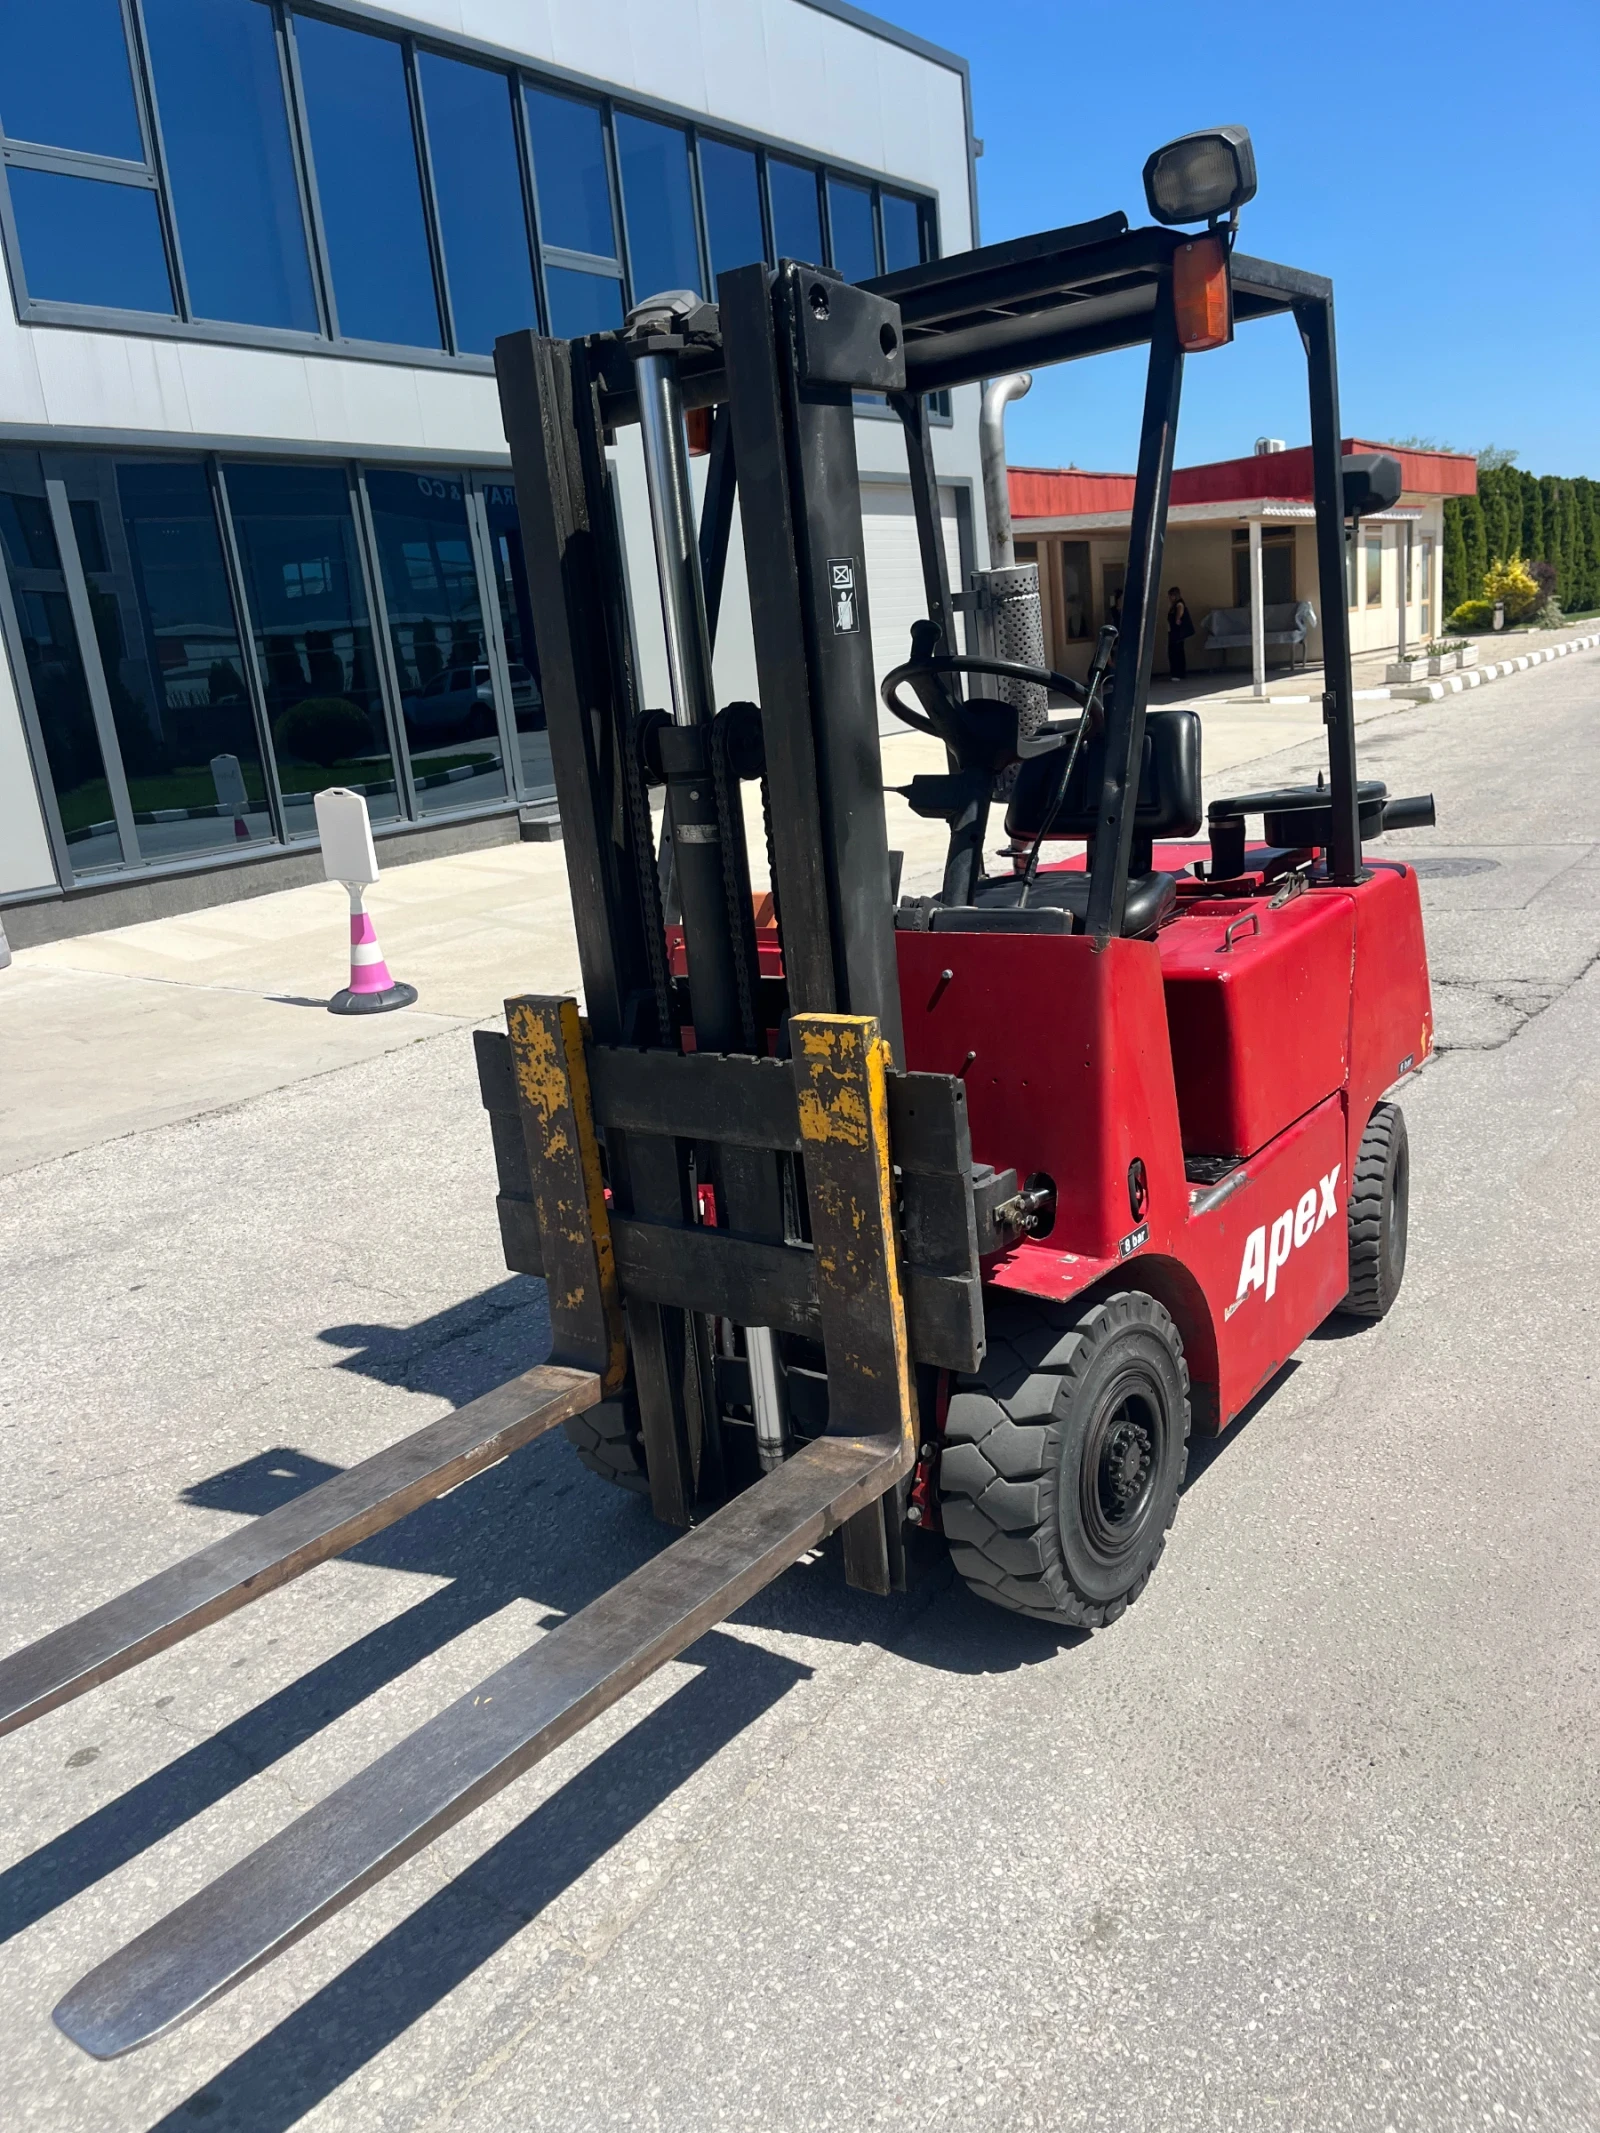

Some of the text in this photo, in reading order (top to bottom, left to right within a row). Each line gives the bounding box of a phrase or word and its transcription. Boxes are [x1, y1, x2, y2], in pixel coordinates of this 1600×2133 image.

[1125, 1230, 1145, 1252] 8 bar
[1235, 1163, 1341, 1303] Apex
